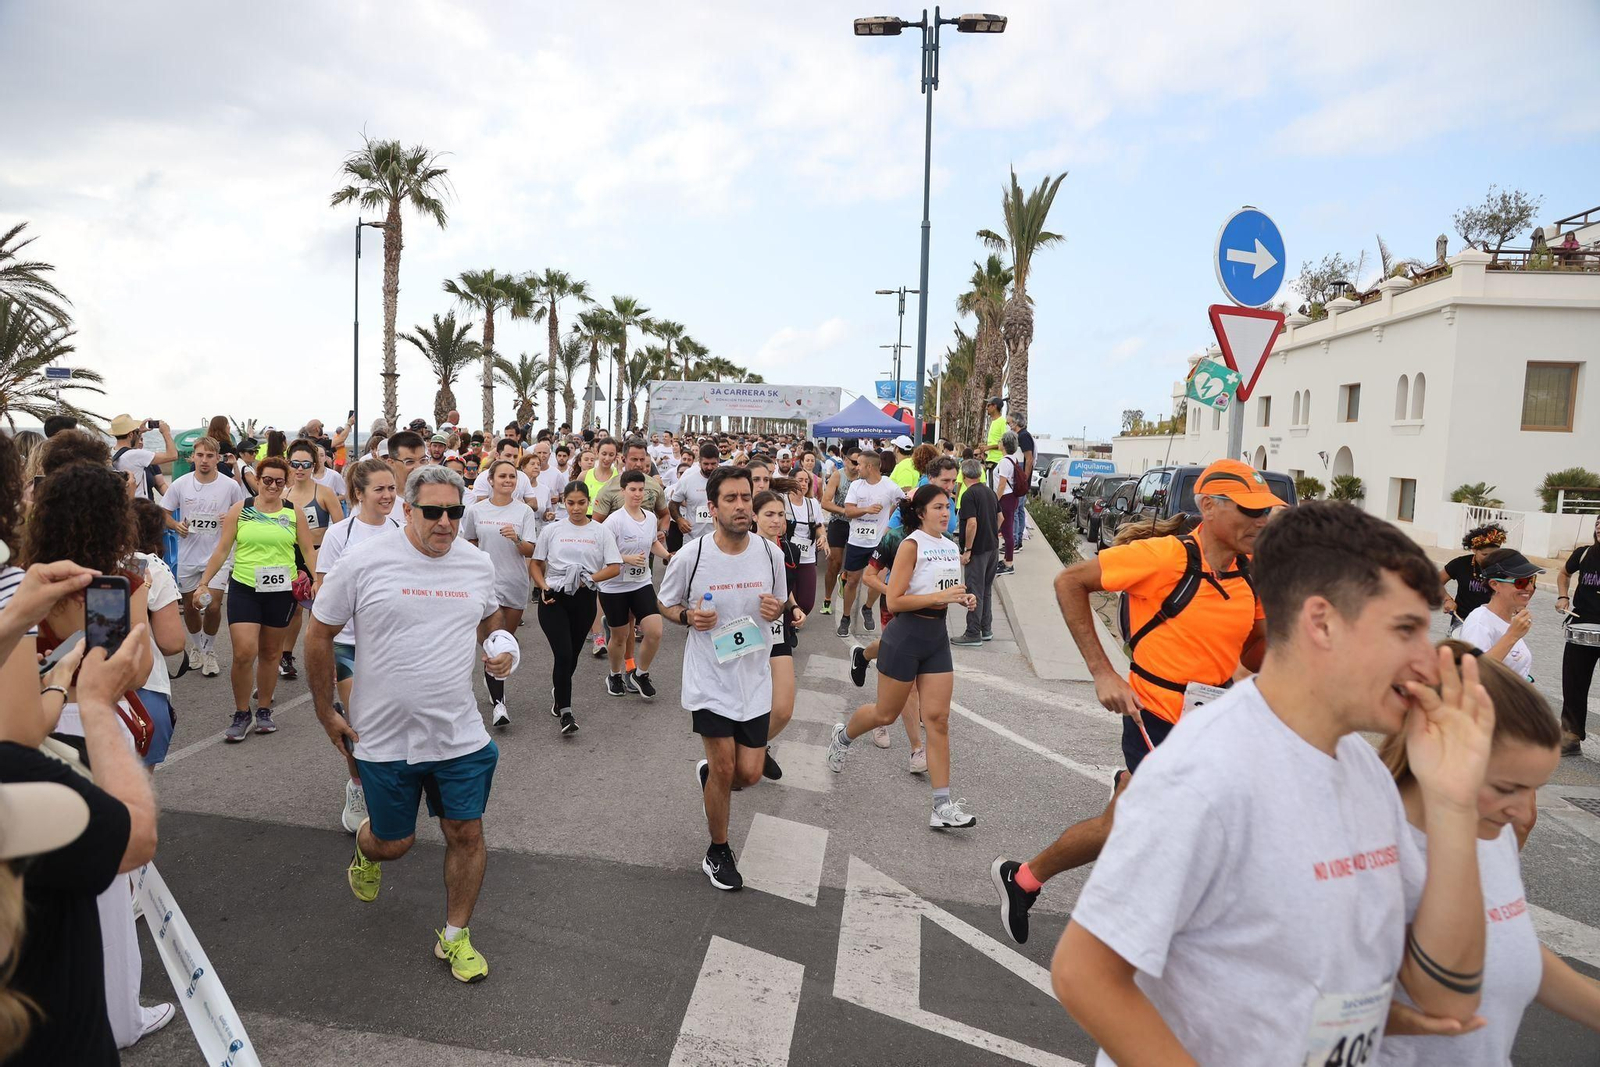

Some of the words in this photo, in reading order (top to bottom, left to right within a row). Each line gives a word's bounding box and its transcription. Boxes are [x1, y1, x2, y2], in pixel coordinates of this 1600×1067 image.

[724, 388, 765, 396] CARRERA
[307, 514, 315, 523] 2
[191, 519, 217, 528] 1279
[797, 543, 809, 552] 082
[262, 574, 285, 585] 265
[402, 588, 411, 596] NO
[435, 590, 444, 598] NO
[733, 631, 745, 646] 8
[1313, 861, 1328, 881] NO
[1328, 857, 1354, 878] KIDNE
[1353, 853, 1367, 871] NO
[1367, 845, 1398, 869] EXCUSE
